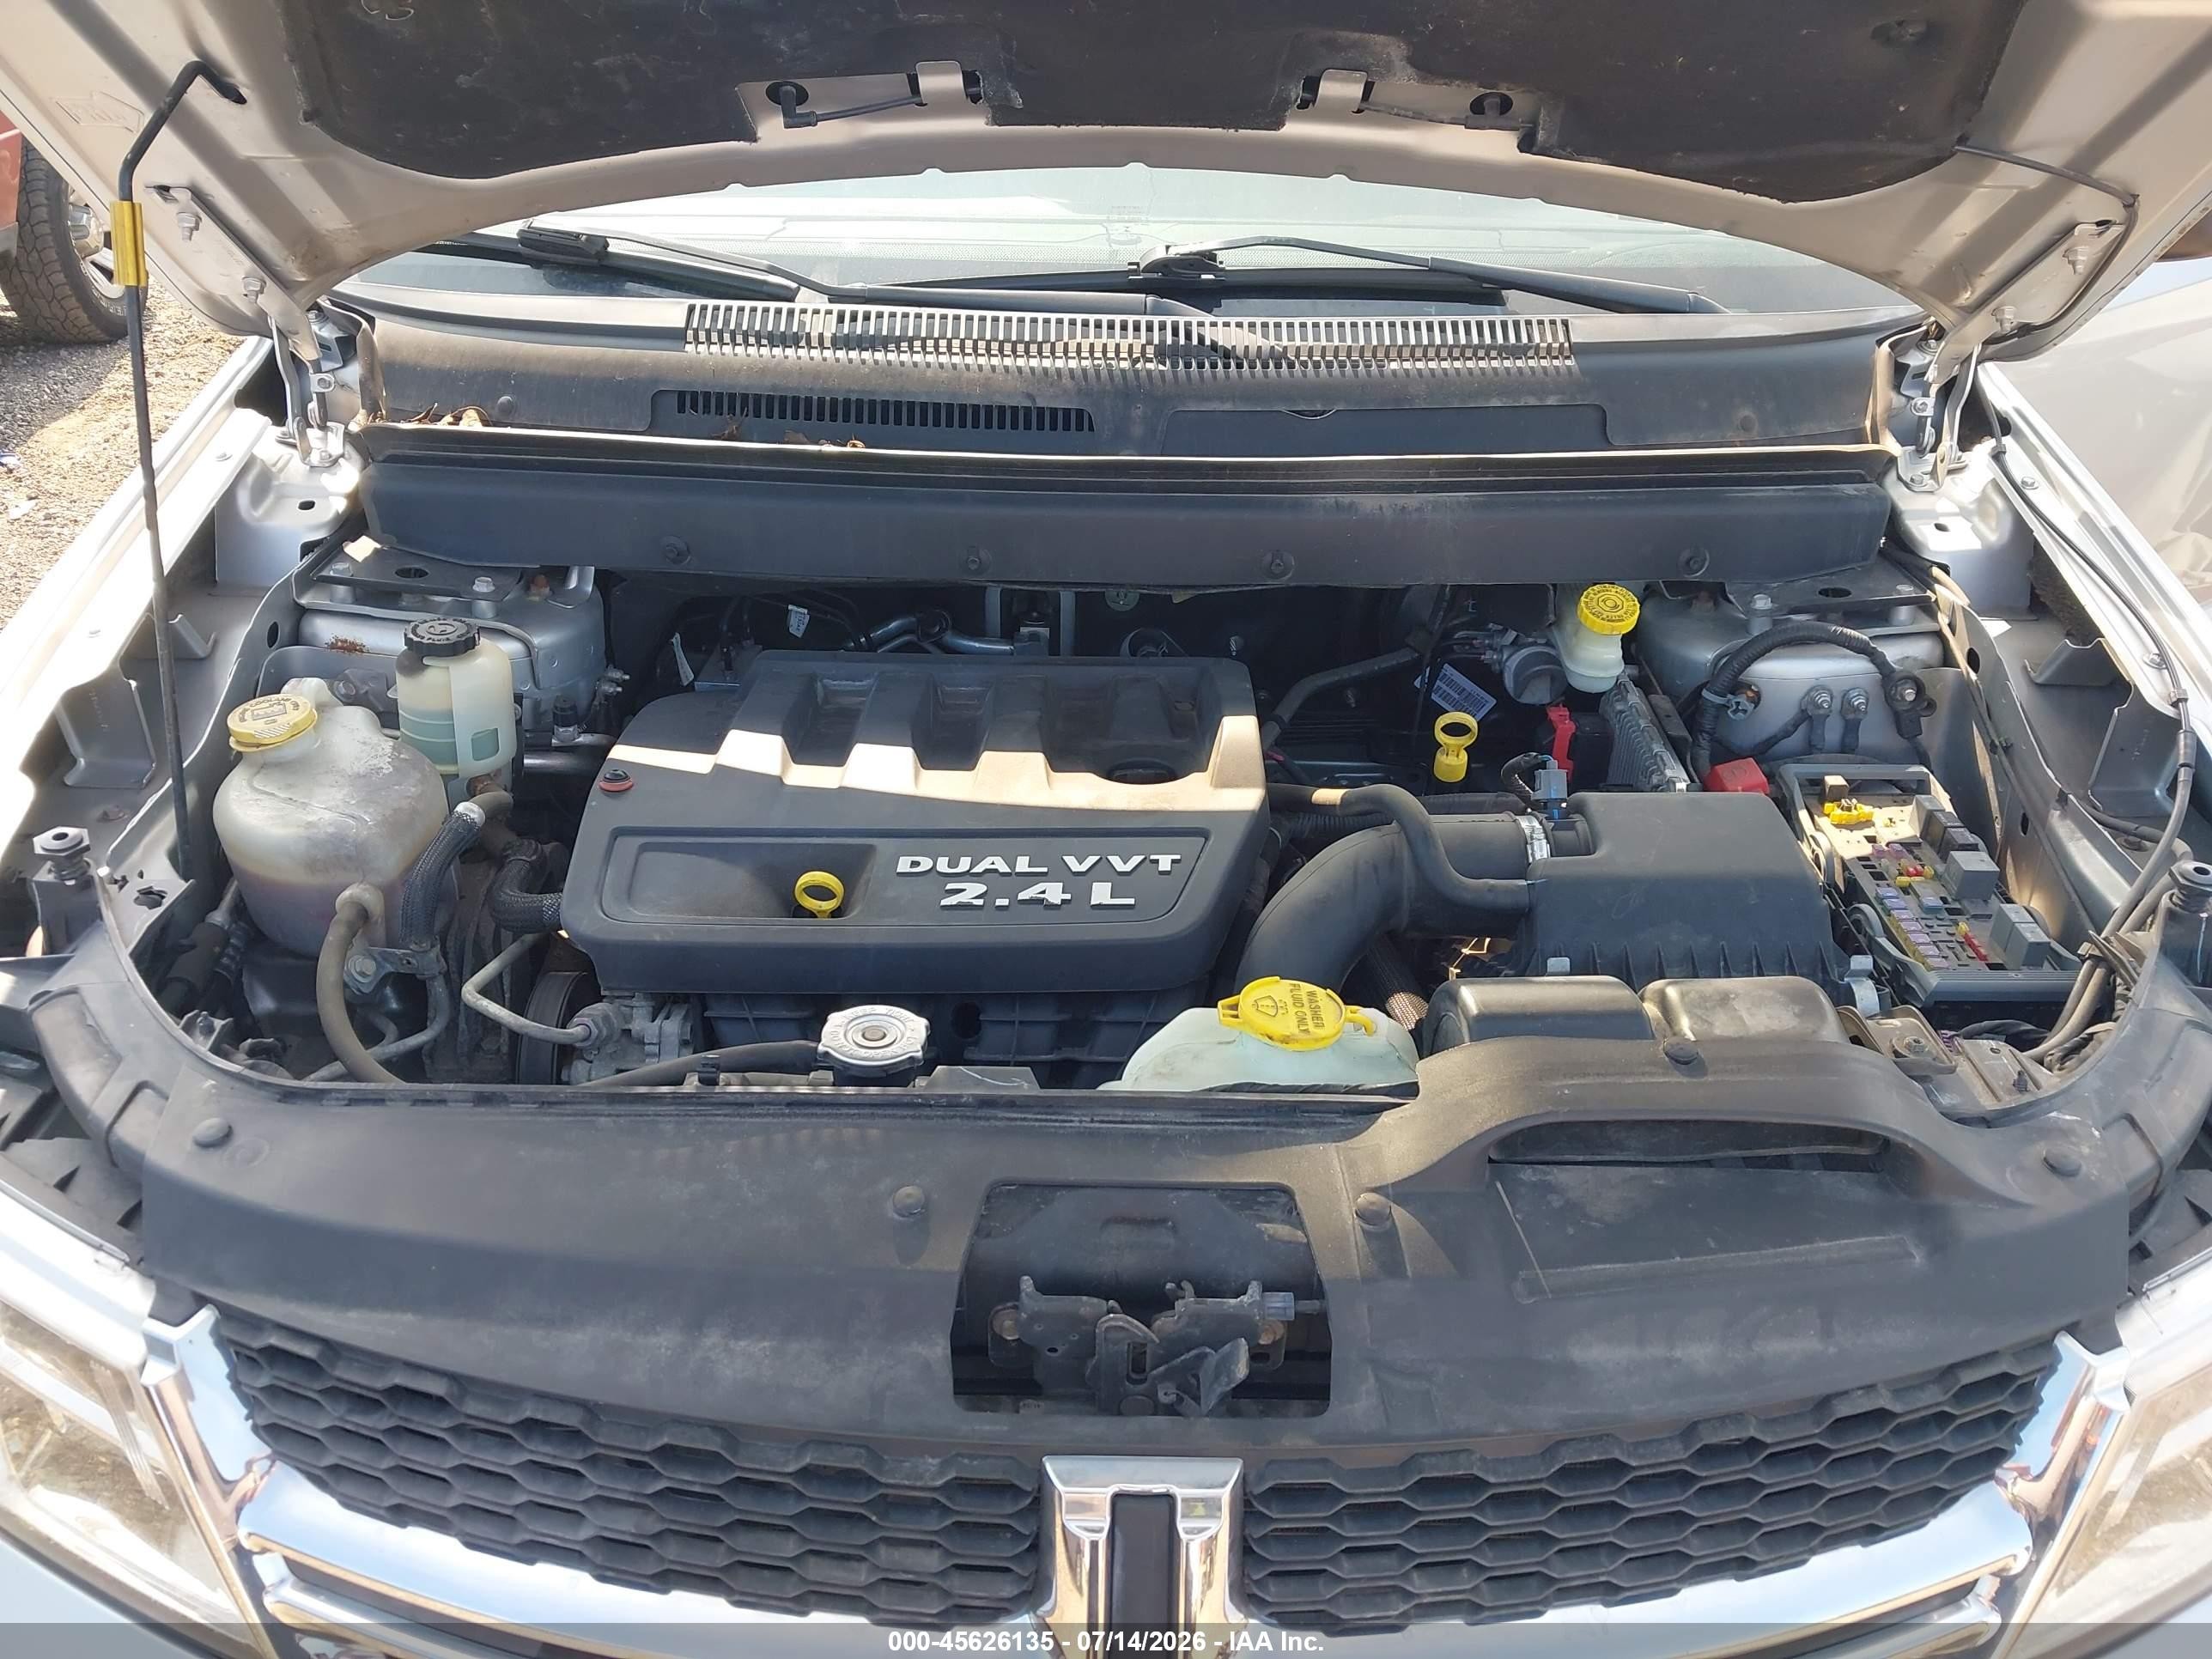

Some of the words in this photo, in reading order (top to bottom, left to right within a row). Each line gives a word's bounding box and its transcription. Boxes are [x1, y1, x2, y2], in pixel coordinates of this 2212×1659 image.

[896, 855, 1048, 874] DUAL
[1061, 854, 1182, 874] VVT
[939, 881, 1072, 908] 2.4
[1091, 881, 1135, 907] L
[1289, 982, 1304, 1008] FLUID
[1294, 1010, 1310, 1035] ONLY
[1305, 990, 1325, 1030] WASHER
